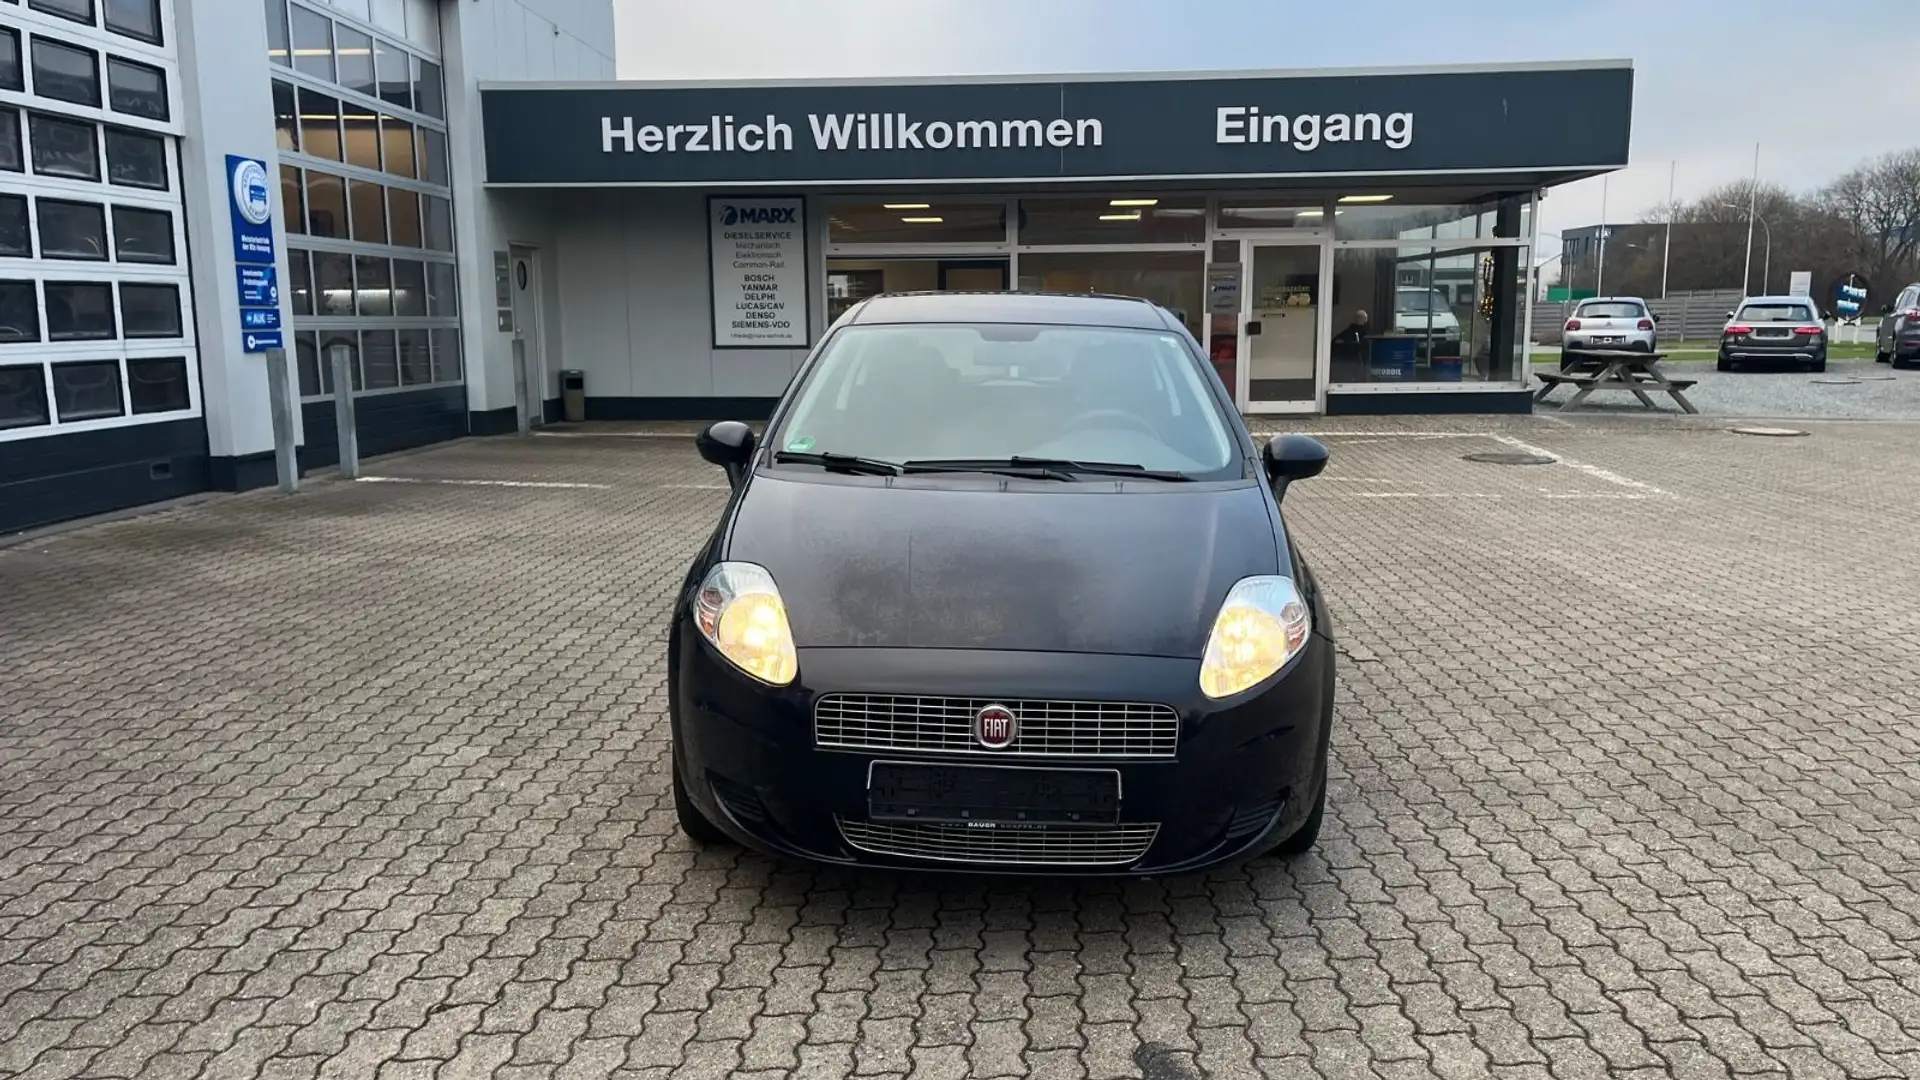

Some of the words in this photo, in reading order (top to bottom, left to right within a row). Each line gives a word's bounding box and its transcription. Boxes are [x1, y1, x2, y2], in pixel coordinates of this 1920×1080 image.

[600, 114, 793, 153] Herzlich
[807, 112, 1104, 151] Willkommen
[1216, 106, 1414, 151] Eingang
[740, 207, 796, 223] MARX
[724, 231, 792, 239] DIESELSERVICE
[735, 241, 781, 249] Mechanisch
[735, 251, 781, 259] Elektronisch
[732, 260, 785, 269] Common-Rail
[744, 274, 775, 282] BOSCH
[741, 283, 778, 291] YANMAR
[744, 293, 776, 301] DELPHI
[735, 302, 785, 310] LUCAS/CAV
[745, 311, 776, 319] DENSO
[731, 320, 791, 329] SIEMENS-VDO
[984, 718, 1009, 738] FIAT
[968, 821, 997, 829] BAUER
